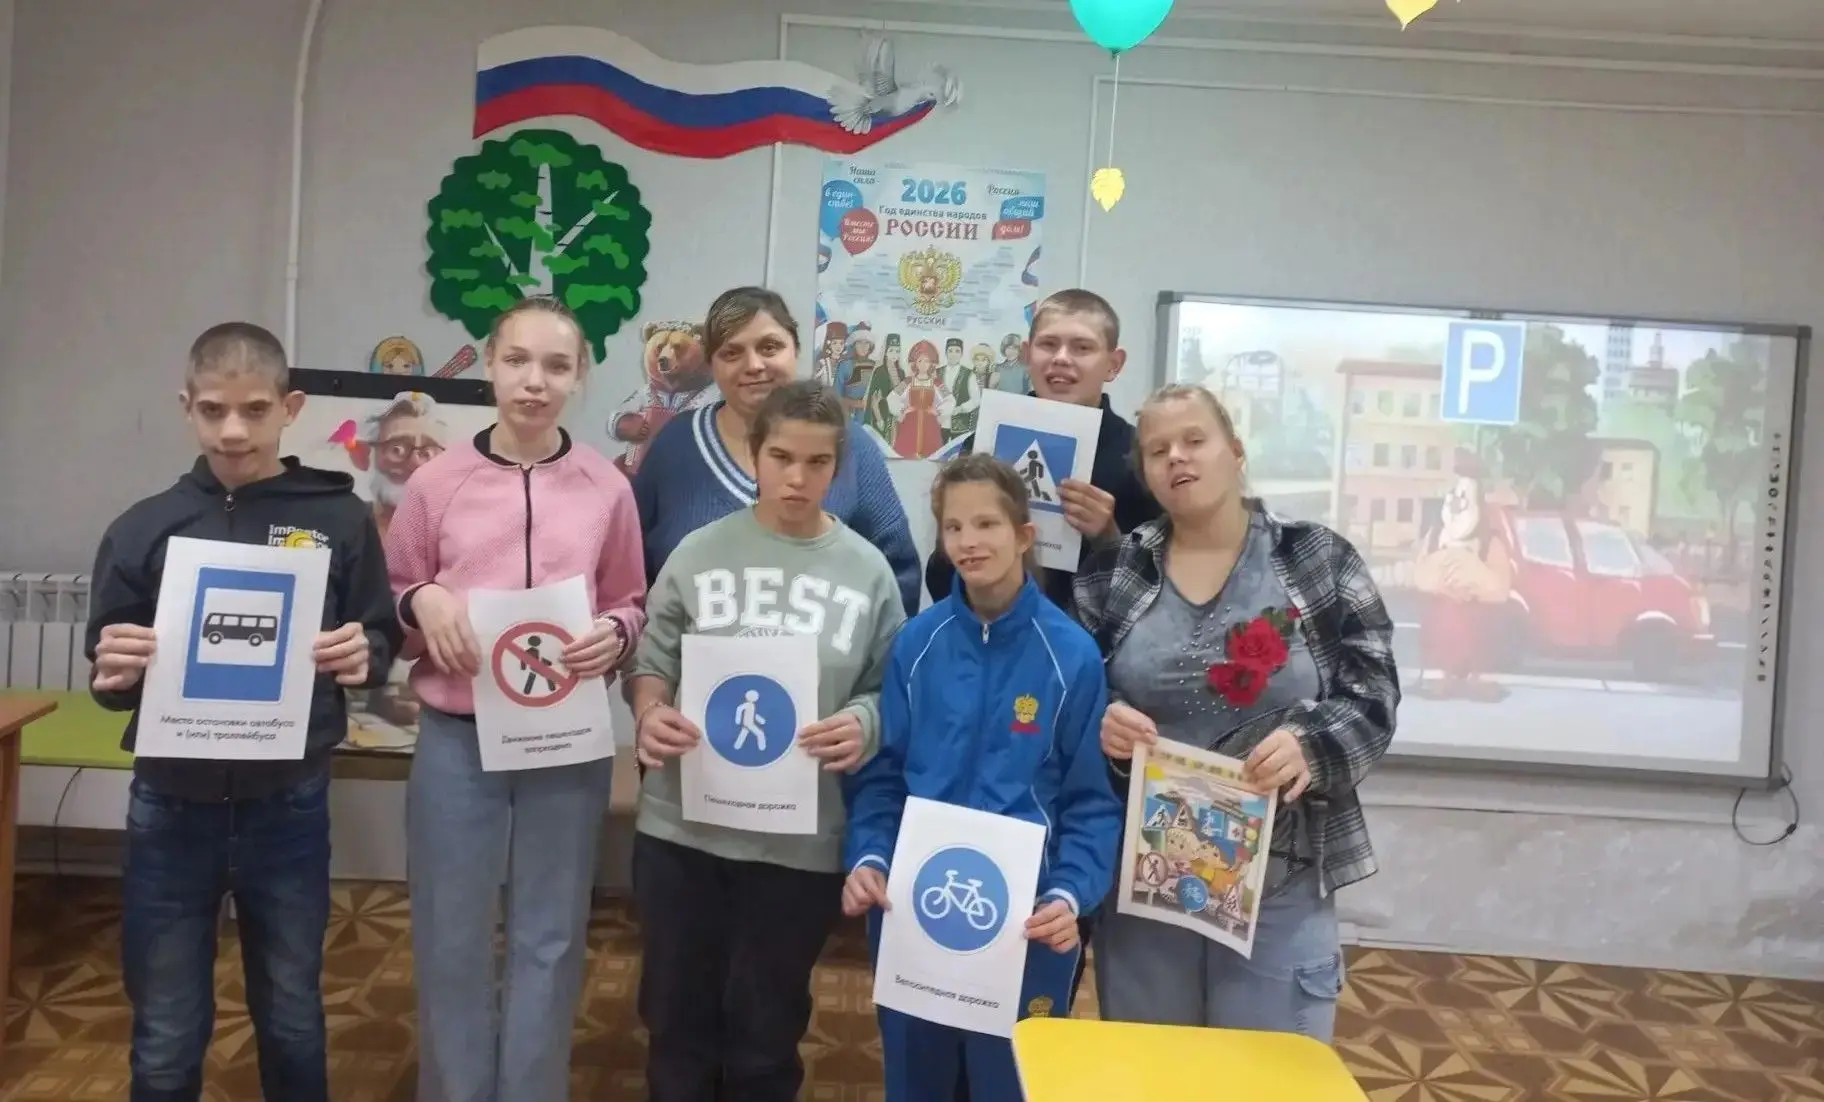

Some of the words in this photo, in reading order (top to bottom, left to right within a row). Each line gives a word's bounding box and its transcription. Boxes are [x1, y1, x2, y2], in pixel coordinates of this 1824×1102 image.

[849, 165, 876, 176] Наша
[901, 178, 967, 206] 2026
[879, 205, 897, 216] Год
[898, 208, 944, 218] единства
[946, 210, 987, 220] народов
[885, 218, 978, 240] РОССИИ
[693, 566, 872, 655] BEST
[160, 715, 194, 725] Место
[196, 718, 248, 727] остановки
[249, 718, 296, 729] автобуса
[185, 729, 211, 740] (или)
[213, 730, 277, 742] троллейбуса
